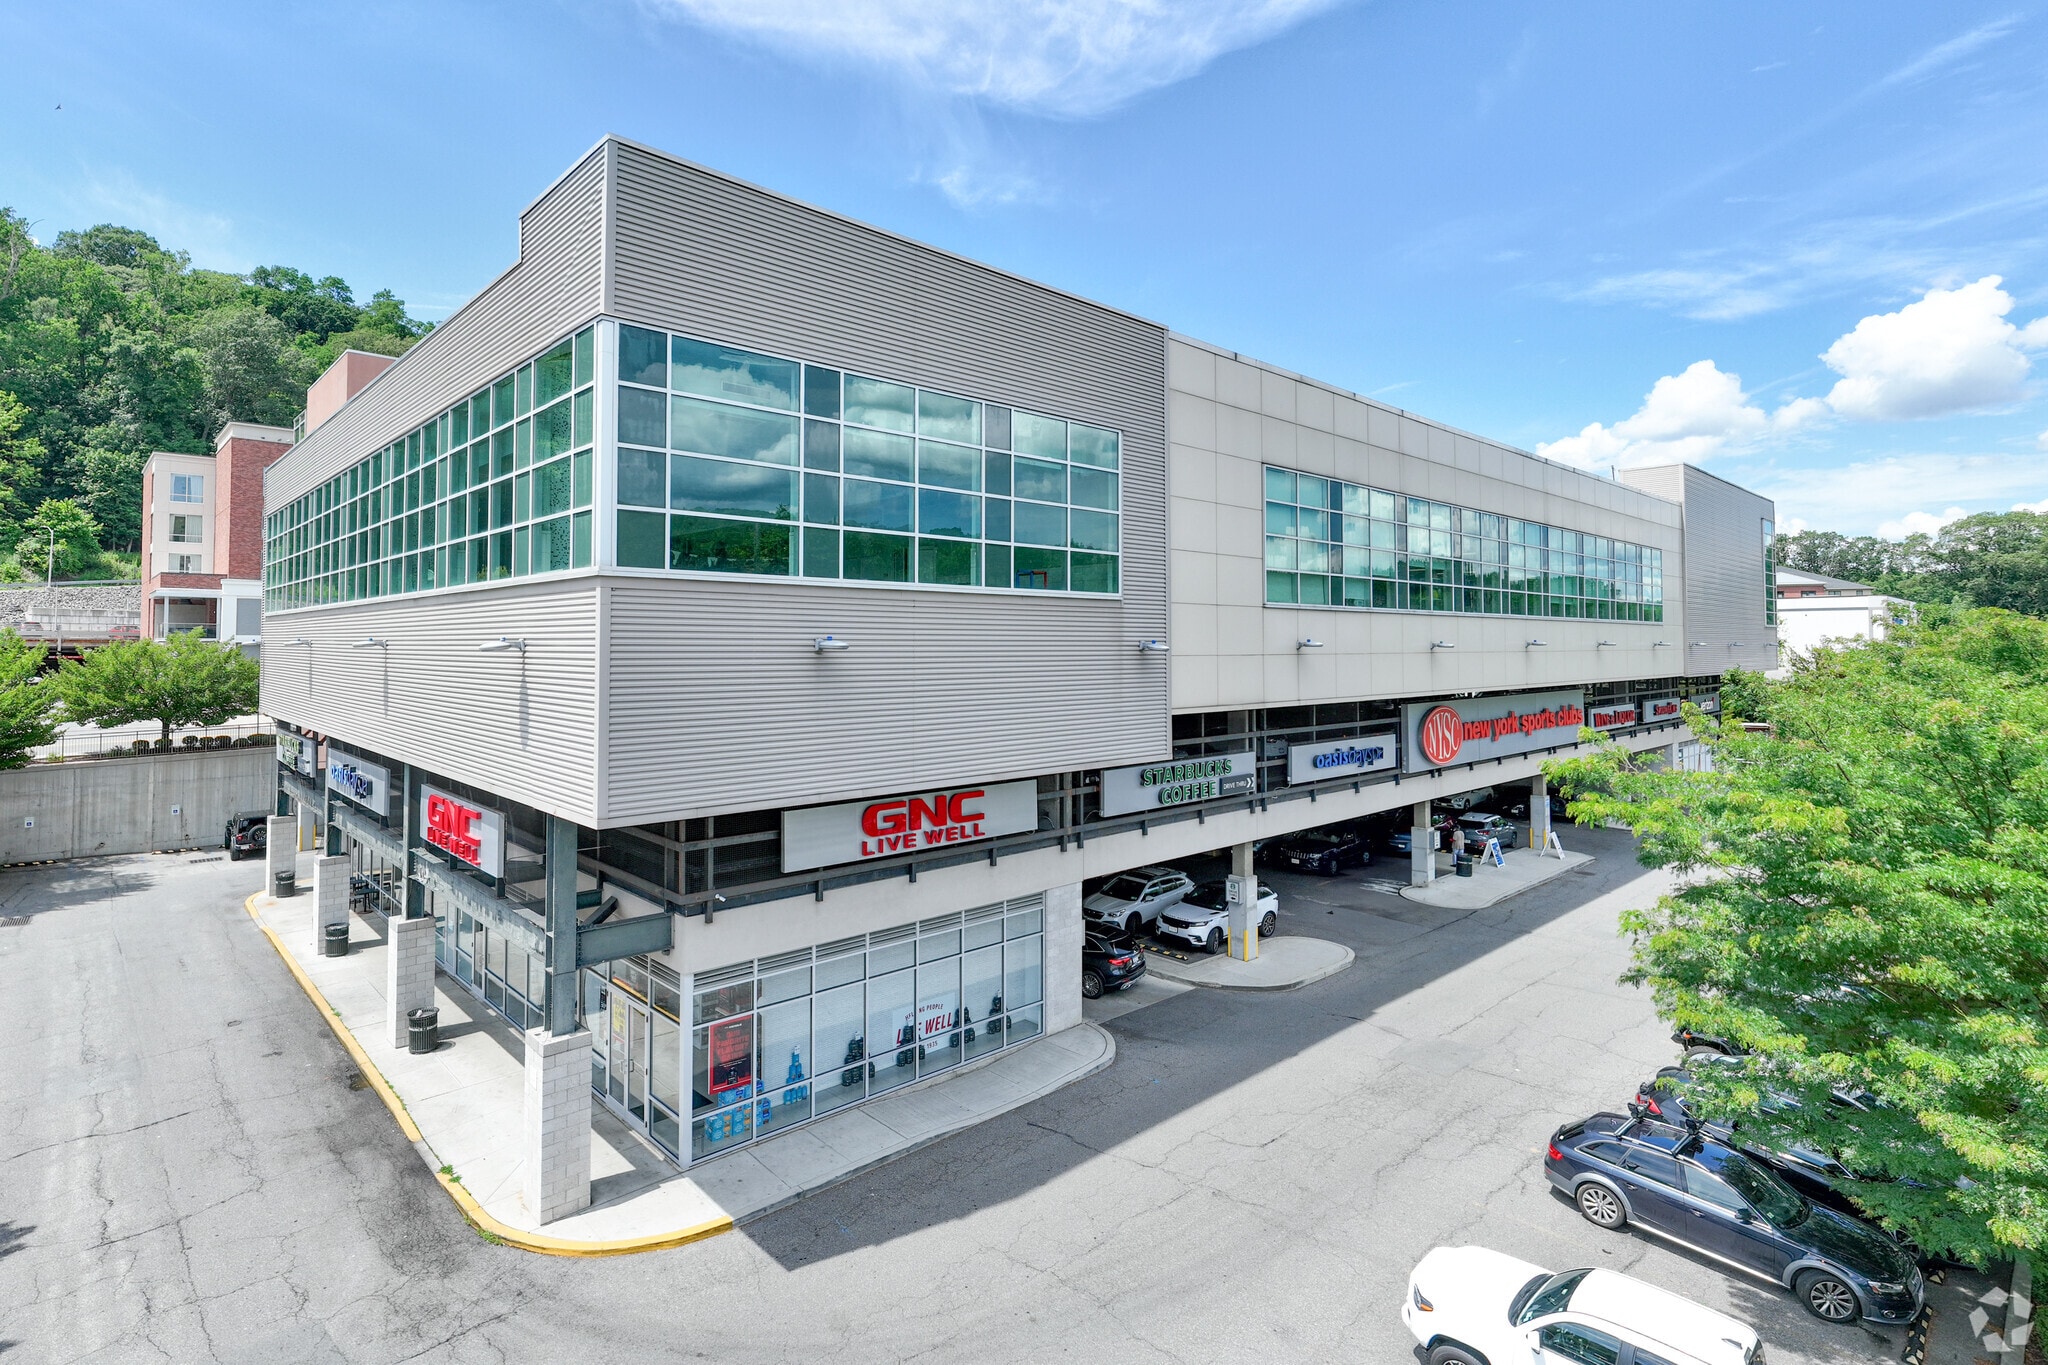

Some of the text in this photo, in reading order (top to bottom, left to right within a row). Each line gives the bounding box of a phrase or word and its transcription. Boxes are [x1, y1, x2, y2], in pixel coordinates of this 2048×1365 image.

[1428, 704, 1583, 760] NYSC new york sports clubs
[1142, 759, 1232, 788] STARBUCKS
[1160, 781, 1217, 806] COFFEE
[427, 794, 482, 847] GNC
[861, 790, 985, 838] GNC
[861, 823, 985, 857] LIVE WELL
[926, 1003, 944, 1011] PEOPLE
[925, 1012, 952, 1035] WELL
